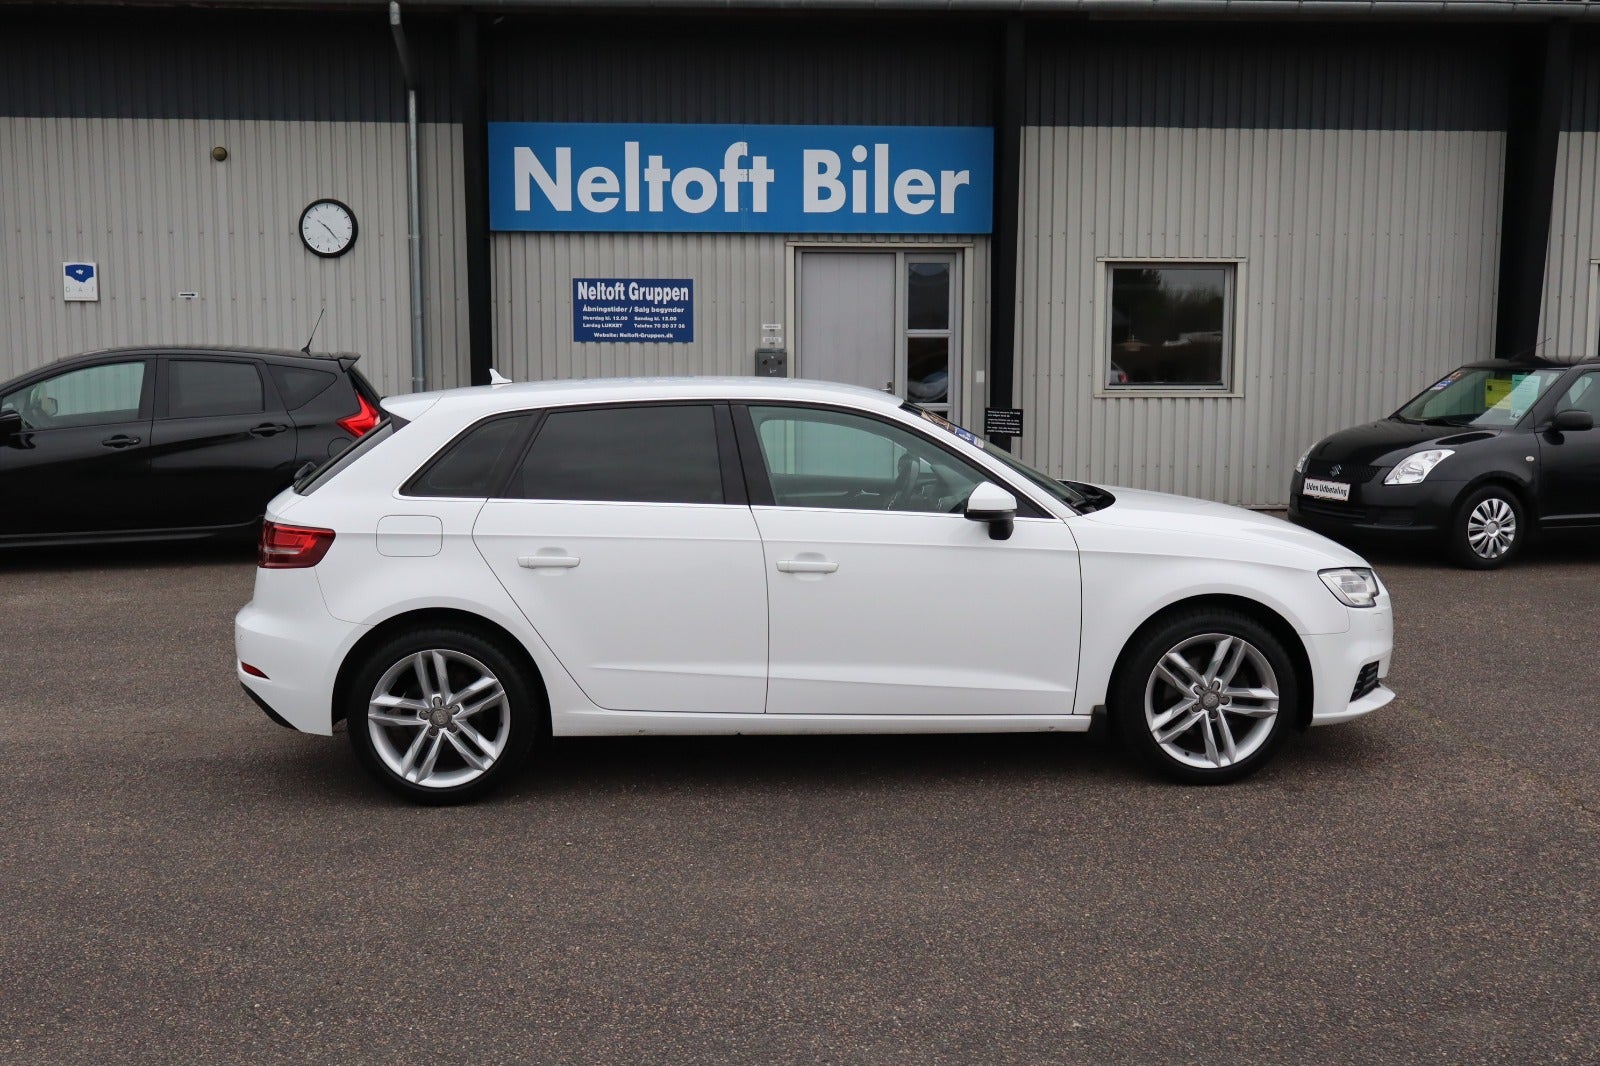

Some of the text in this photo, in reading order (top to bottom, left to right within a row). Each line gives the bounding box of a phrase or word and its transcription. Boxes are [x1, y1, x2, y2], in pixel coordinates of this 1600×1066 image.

[513, 141, 970, 215] Neltoft Biler
[577, 281, 689, 304] Neltoft Gruppen
[582, 304, 628, 313] Åbningstider
[634, 306, 650, 314] Salg
[651, 306, 685, 314] begynder
